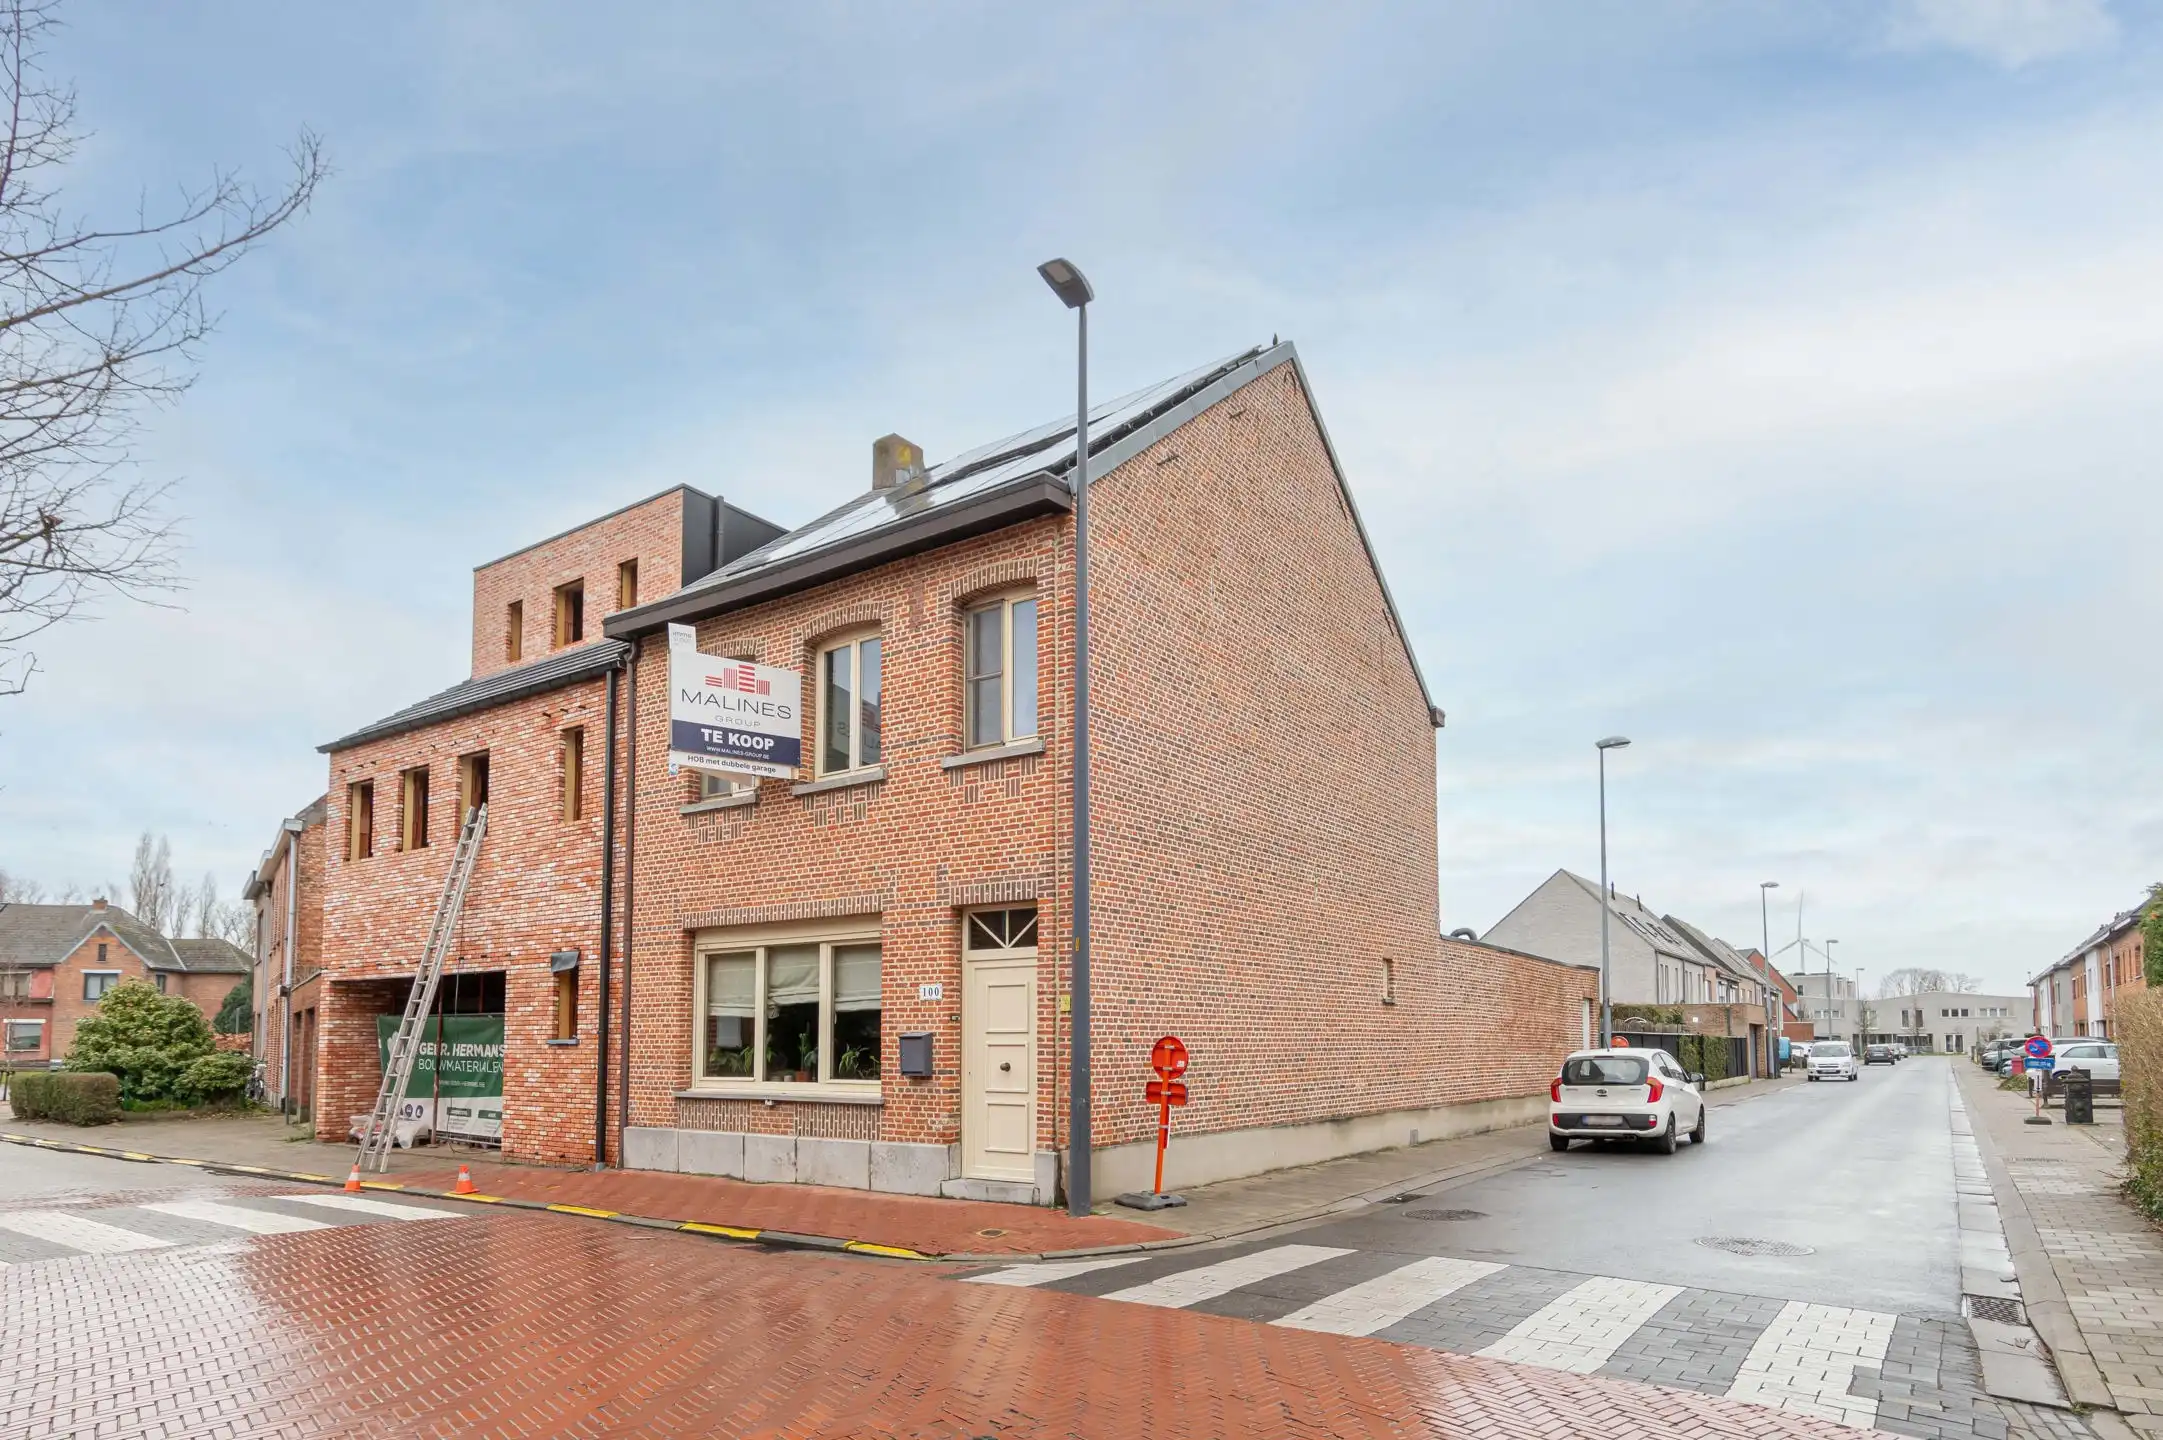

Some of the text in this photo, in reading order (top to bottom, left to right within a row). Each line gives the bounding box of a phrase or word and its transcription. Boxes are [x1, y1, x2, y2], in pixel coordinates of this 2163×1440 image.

[681, 688, 792, 720] MALINES
[714, 715, 761, 727] GROUP
[700, 728, 775, 751] TE KOOP
[705, 758, 720, 766] met
[721, 759, 750, 769] dubbele
[751, 765, 776, 773] garage
[923, 987, 939, 997] 100
